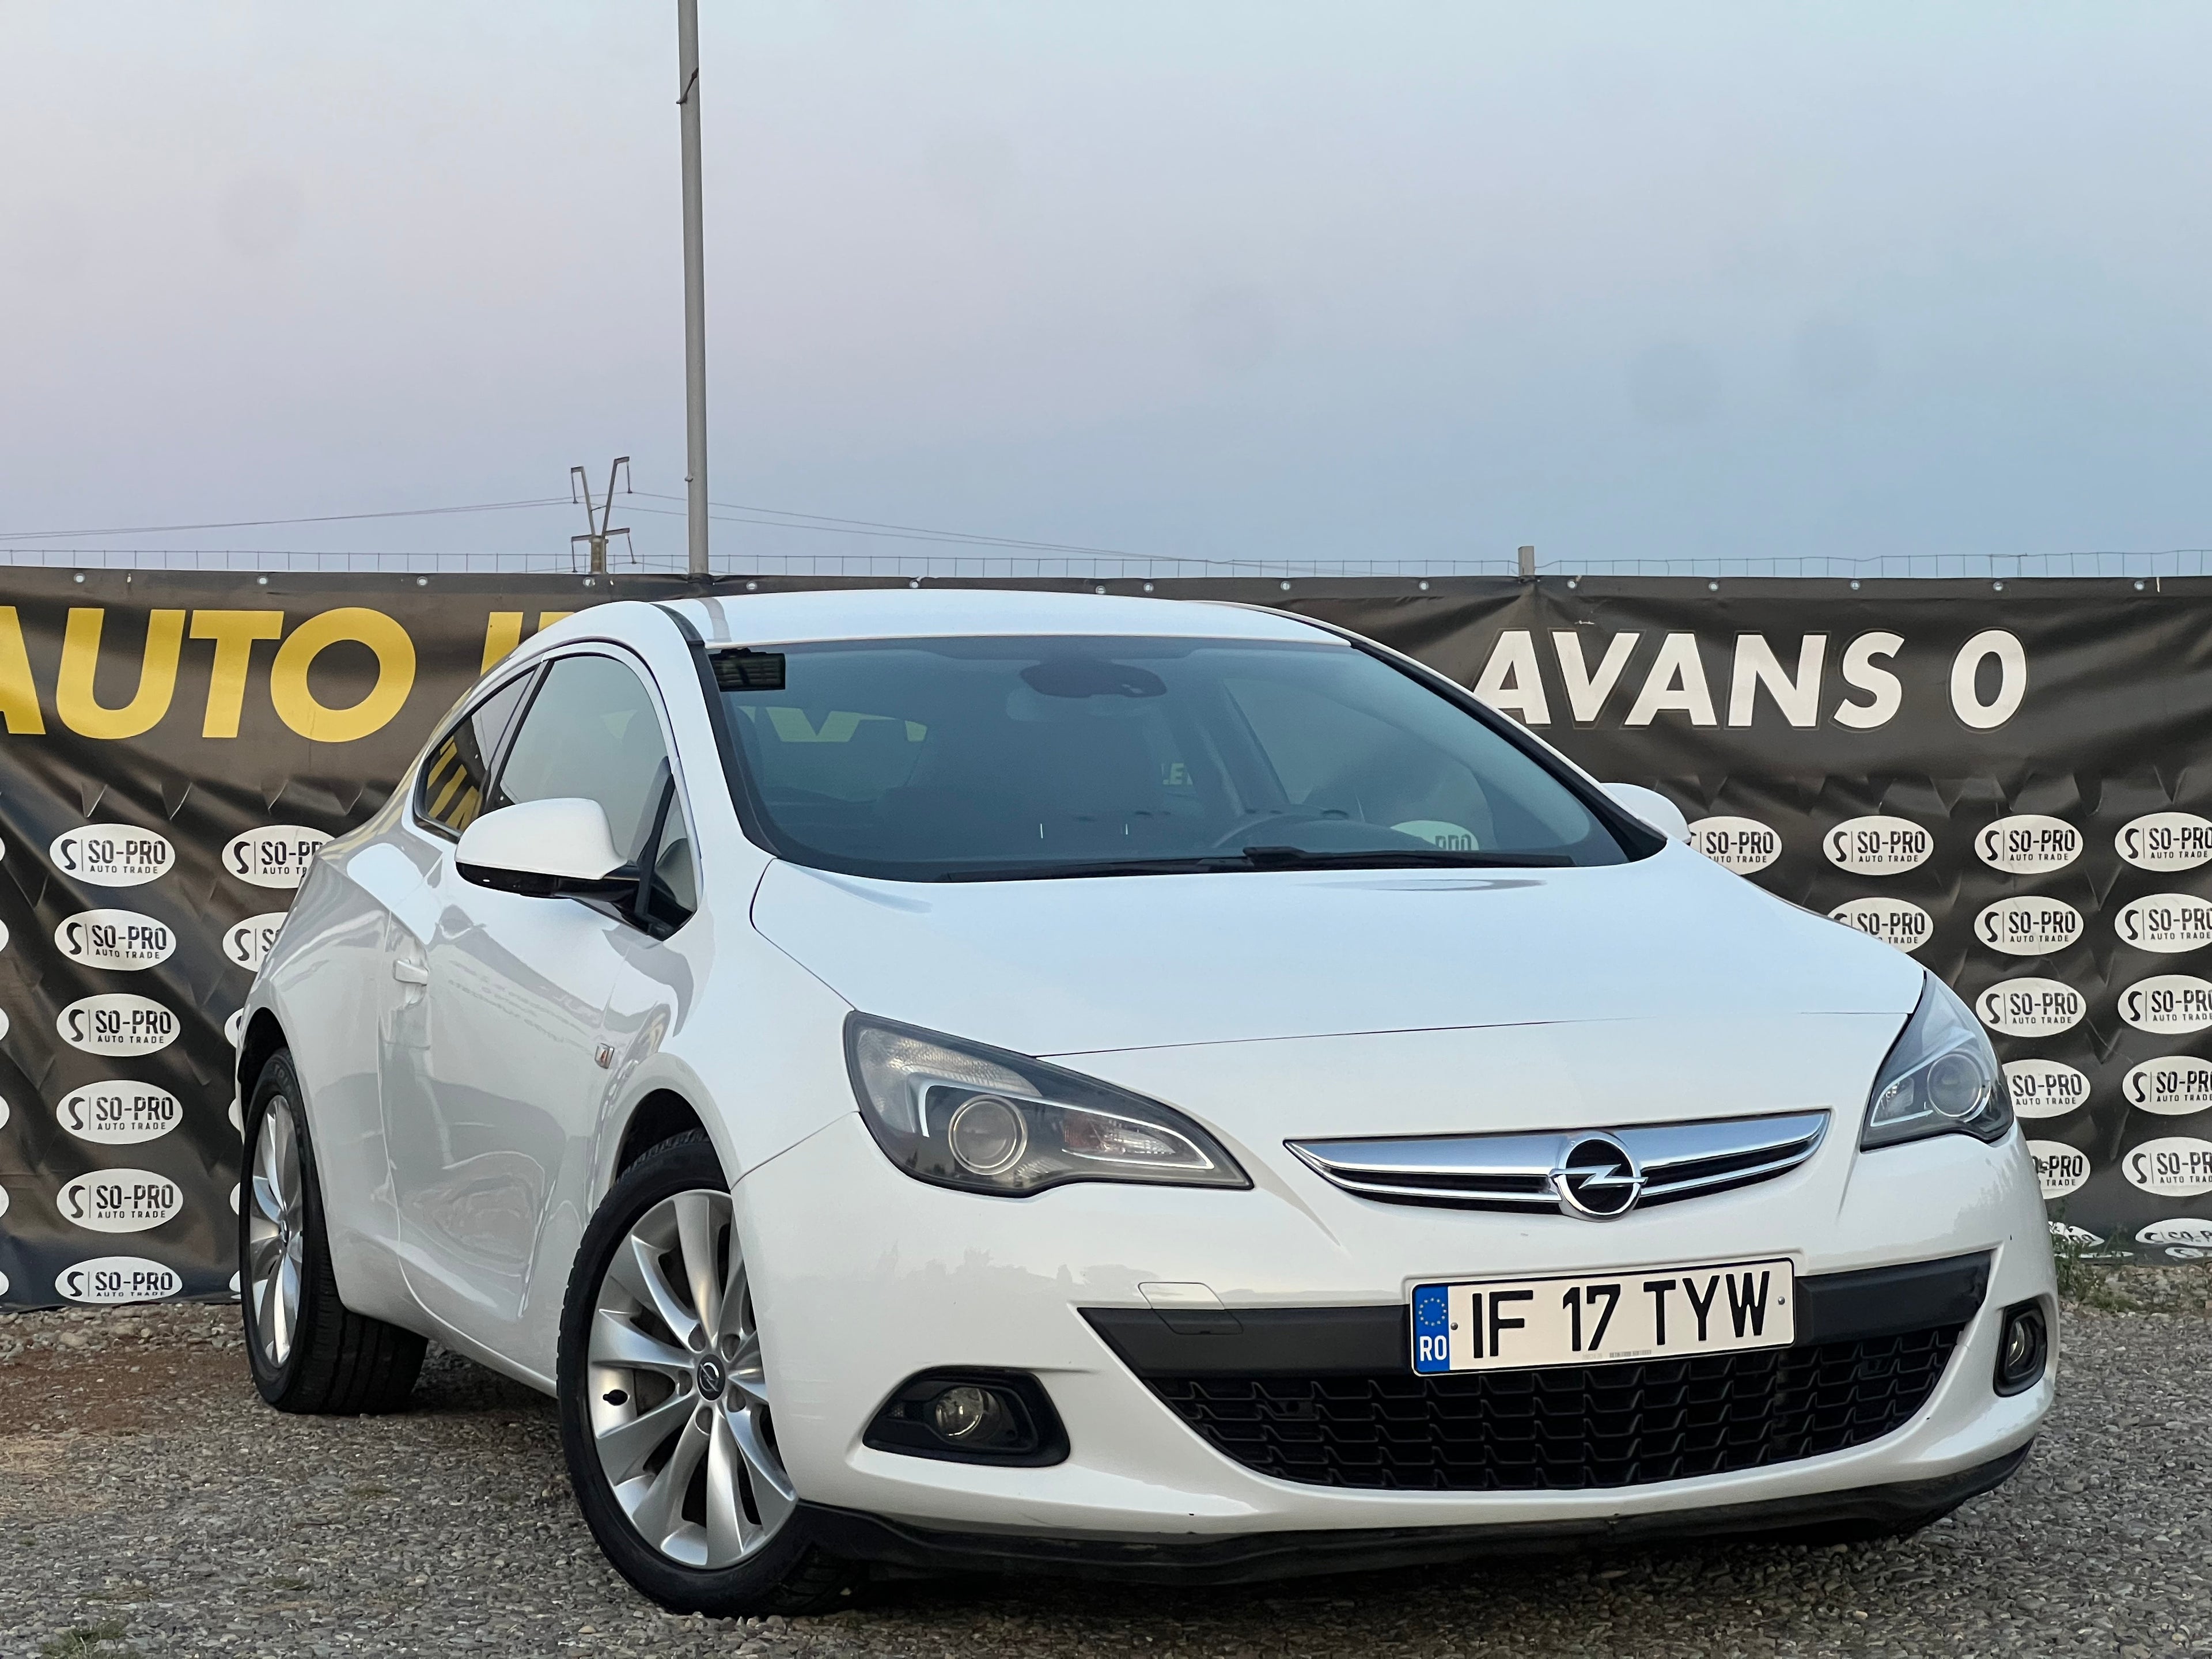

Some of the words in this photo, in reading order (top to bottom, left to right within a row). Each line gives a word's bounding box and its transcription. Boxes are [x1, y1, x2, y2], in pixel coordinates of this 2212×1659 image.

[1474, 630, 1906, 729] AVANS
[88, 840, 166, 865] SO-PRO
[1706, 831, 1774, 854] SO-PRO
[1857, 831, 1926, 854] SO-PRO
[2009, 829, 2075, 853] SO-PRO
[1736, 855, 1767, 863] TRADE
[1888, 854, 1918, 862] TRADE
[2179, 850, 2208, 858] TRADE
[90, 865, 117, 873] AUTO
[123, 866, 158, 874] TRADE
[262, 866, 290, 874] AUTO
[1857, 912, 1925, 935] SO-PRO
[2008, 910, 2075, 934] SO-PRO
[91, 925, 167, 950] SO-PRO
[1888, 936, 1918, 944] TRADE
[2039, 934, 2069, 942] TRADE
[2180, 931, 2211, 940] TRADE
[95, 948, 120, 958] AUTO
[125, 950, 160, 959] TRADE
[2010, 992, 2078, 1016] SO-PRO
[95, 1010, 172, 1035] SO-PRO
[2041, 1016, 2072, 1024] TRADE
[97, 1035, 124, 1043] AUTO
[129, 1036, 164, 1044] TRADE
[2012, 1073, 2082, 1097] SO-PRO
[2156, 1070, 2212, 1094] SO-PR
[96, 1096, 174, 1121] SO-PRO
[2016, 1097, 2041, 1105] AUTO
[2046, 1097, 2076, 1105] TRADE
[97, 1122, 125, 1130] AUTO
[131, 1122, 166, 1130] TRADE
[2156, 1152, 2212, 1175] SO-PR
[2160, 1176, 2184, 1184] AUTO
[96, 1184, 174, 1210] SO-PRO
[97, 1210, 125, 1219] AUTO
[131, 1210, 166, 1218] TRADE
[94, 1271, 173, 1291] SO-PRO
[1472, 1289, 1533, 1359] IF
[1562, 1283, 1622, 1352] 17
[1643, 1270, 1771, 1347] TYW
[1419, 1335, 1447, 1362] RO
